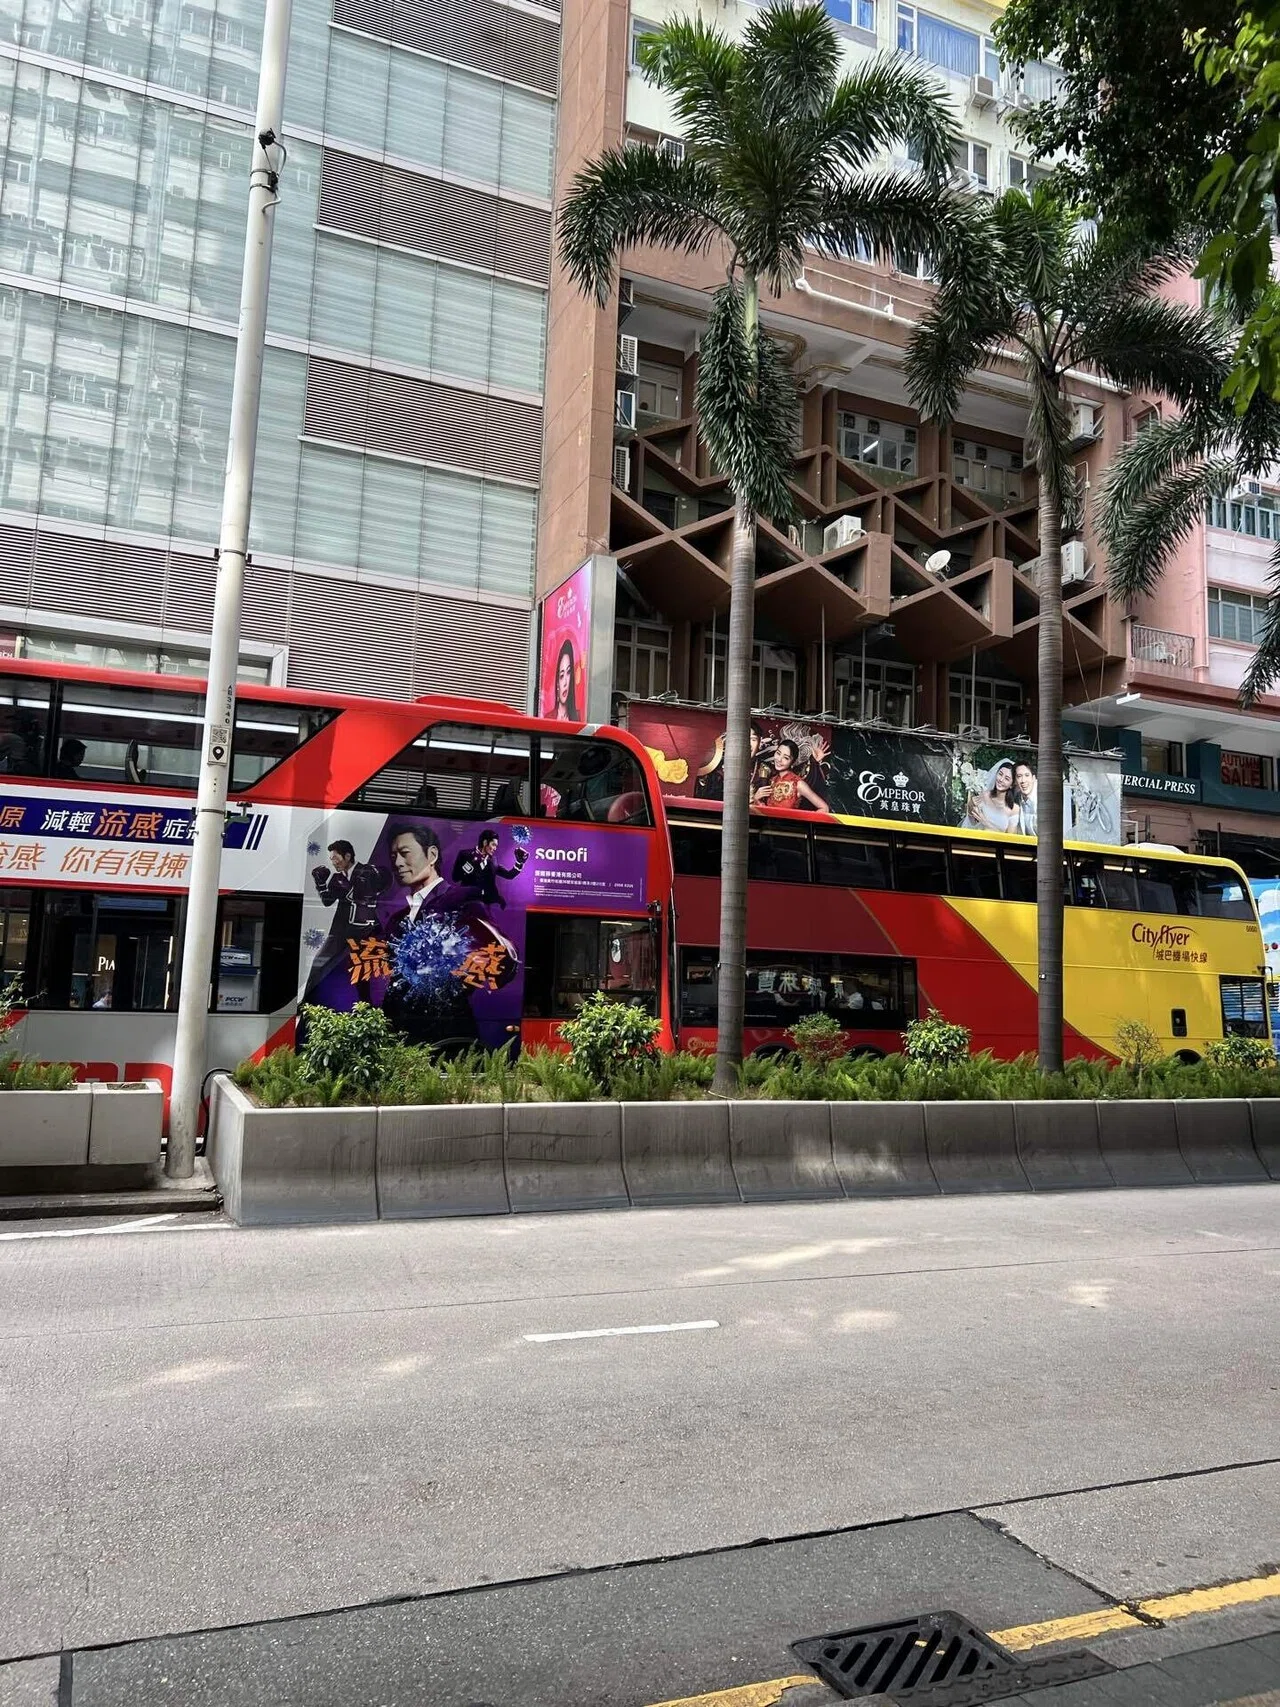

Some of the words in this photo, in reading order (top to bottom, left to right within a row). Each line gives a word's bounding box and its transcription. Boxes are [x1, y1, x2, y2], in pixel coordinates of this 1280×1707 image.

[857, 770, 926, 804] EMPEROR
[1164, 780, 1196, 795] PRESS
[1222, 766, 1260, 788] SALE
[0, 805, 27, 828] 原
[880, 800, 921, 814] 英皇珠寶
[60, 846, 192, 879] 你有得揀
[535, 847, 588, 862] sanofi
[1131, 922, 1191, 949] Cityflyer
